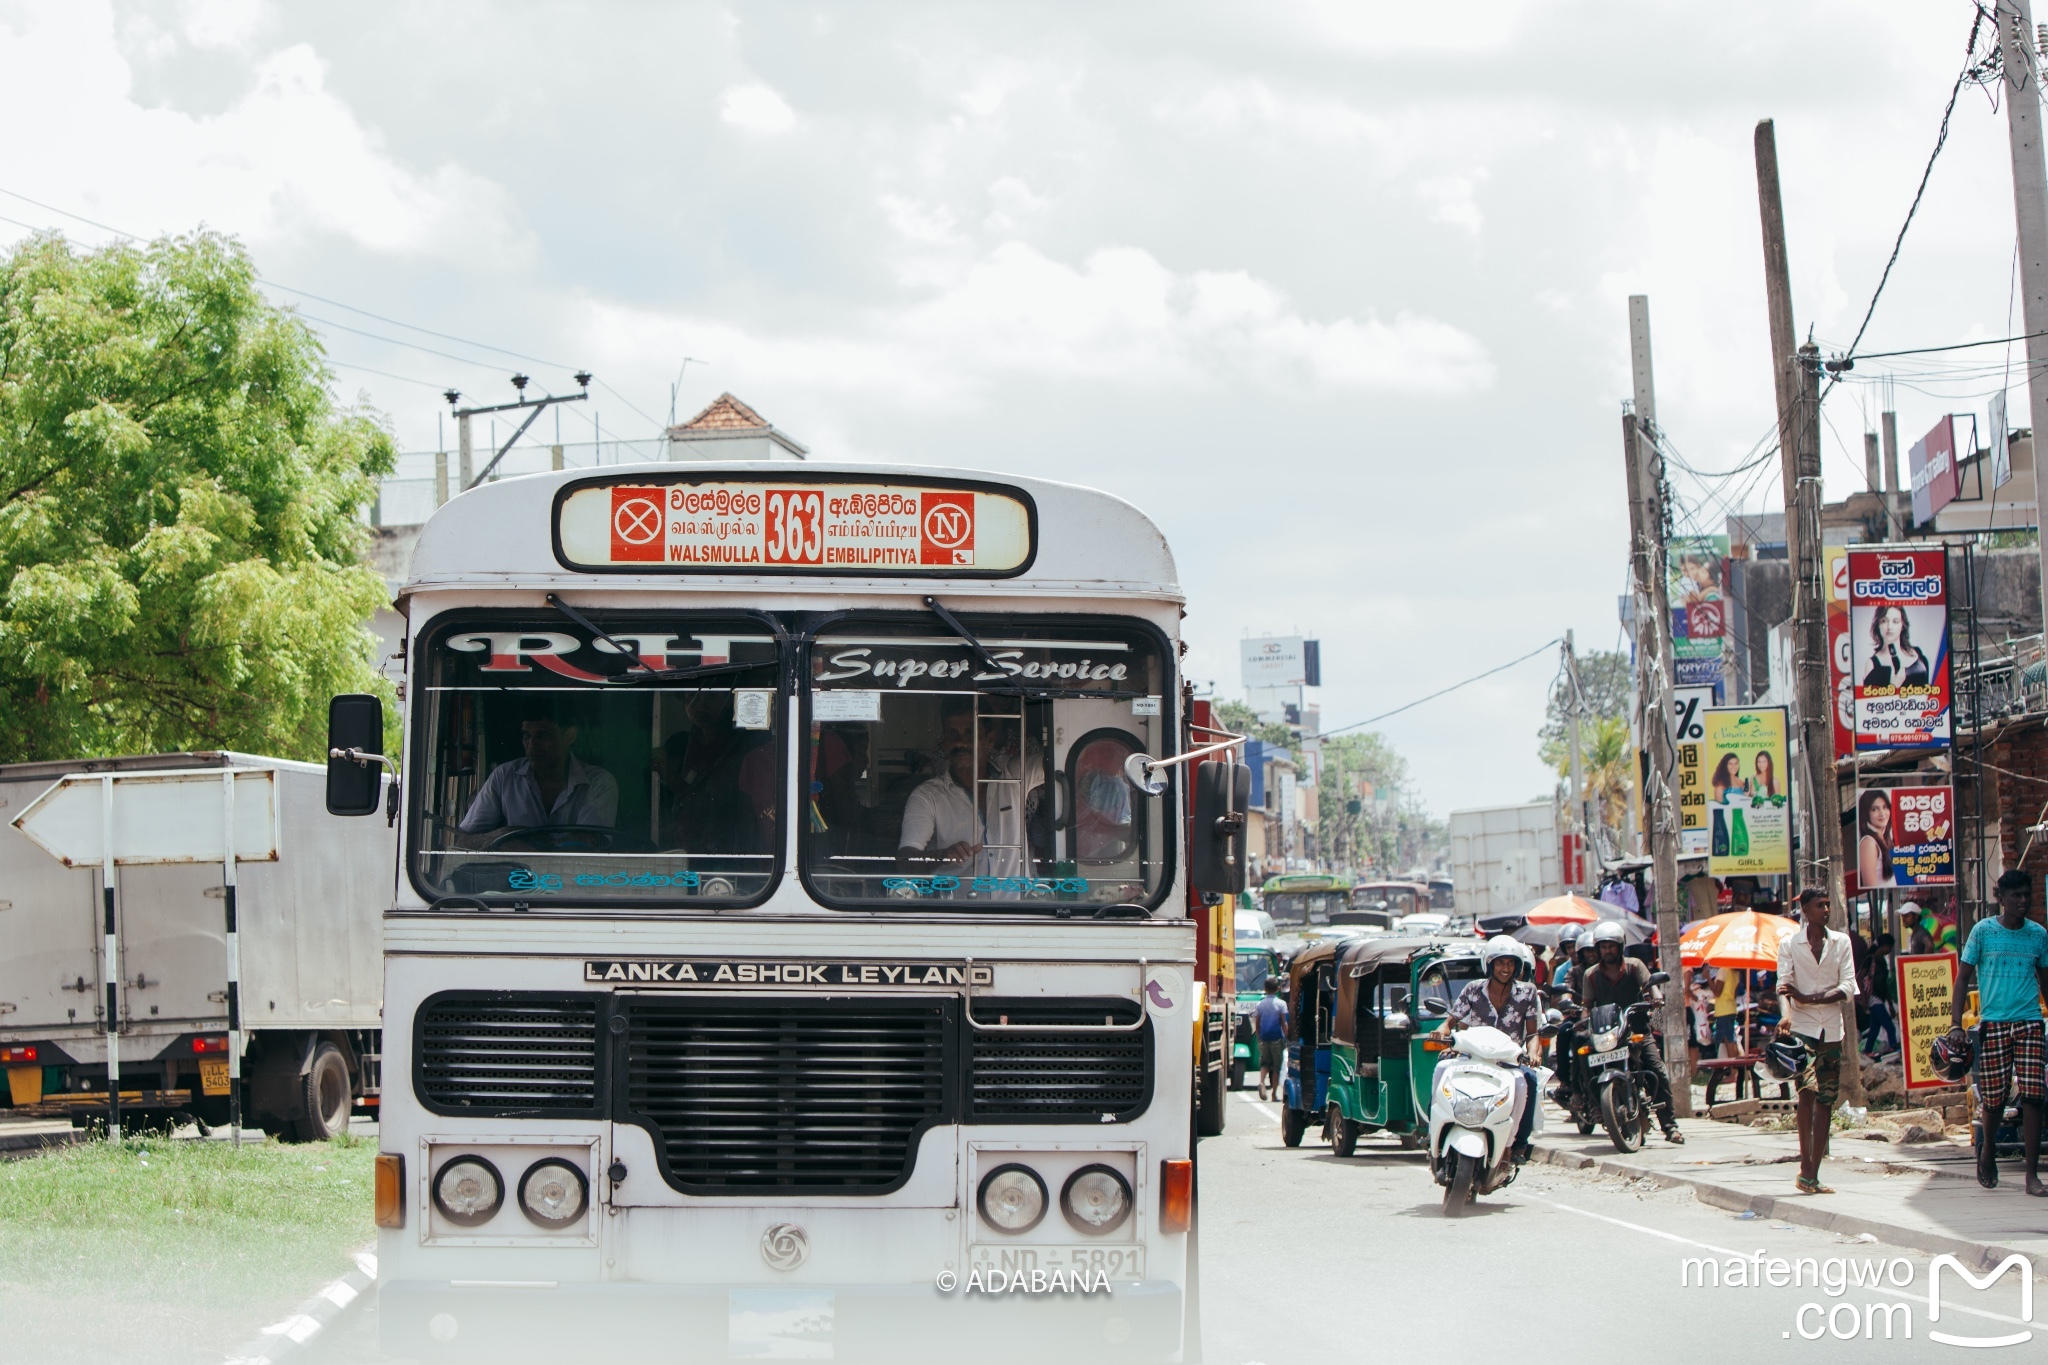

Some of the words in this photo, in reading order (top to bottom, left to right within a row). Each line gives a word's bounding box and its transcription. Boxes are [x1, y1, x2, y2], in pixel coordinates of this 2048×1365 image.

[670, 489, 760, 516] වලස්මුල්ල
[829, 494, 916, 518] ඇඹිලිපිටිය
[671, 517, 759, 540] வலஸ்முல்ல
[767, 493, 822, 561] 363
[670, 545, 760, 562] WALSMULLA
[827, 547, 917, 564] EMBILIPITIYA
[1880, 557, 1914, 576] සන්
[1692, 623, 1719, 635] AIA
[815, 648, 970, 687] Super
[972, 651, 1128, 681] Service
[1741, 741, 1775, 749] shampoo
[508, 869, 563, 890] බුදු
[1725, 941, 1763, 952] airtel
[586, 963, 698, 981] LANKA
[713, 964, 828, 983] ASHOK
[841, 966, 992, 985] LEYLAND
